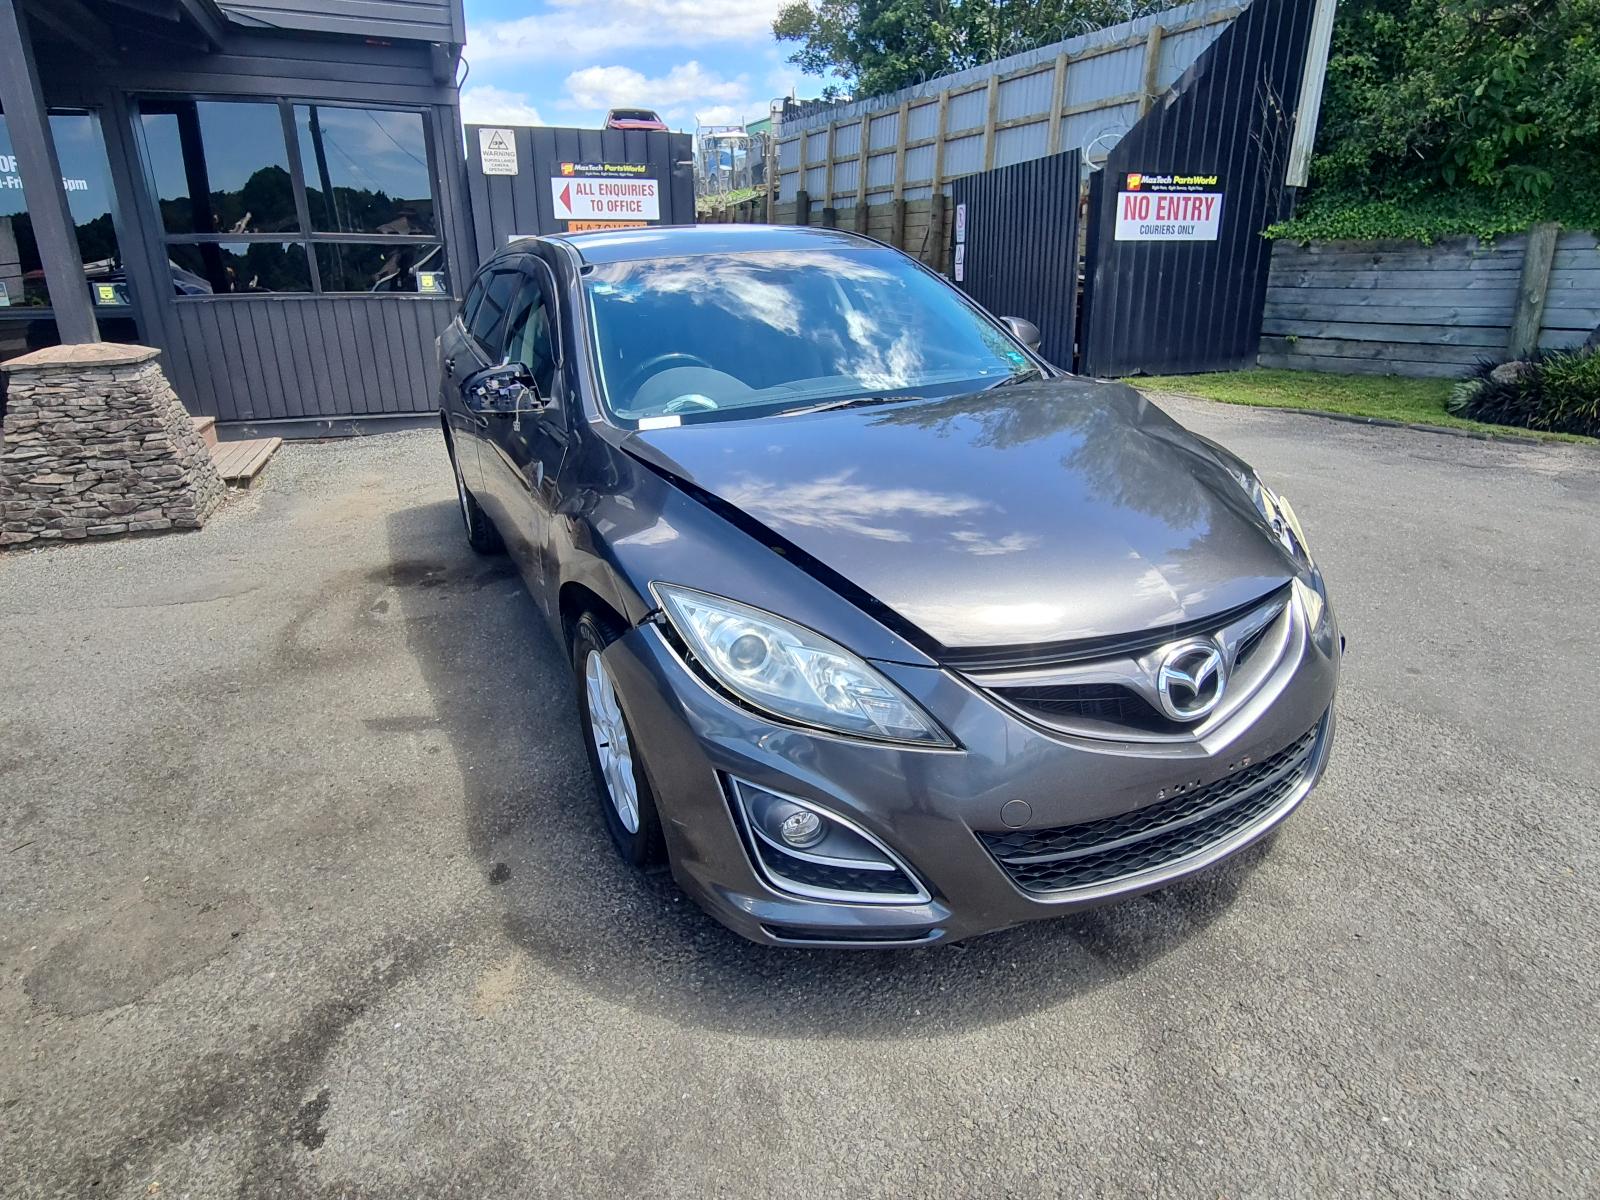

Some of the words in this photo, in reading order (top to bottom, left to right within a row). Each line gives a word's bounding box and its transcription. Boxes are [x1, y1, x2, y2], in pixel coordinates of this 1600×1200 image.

[604, 164, 646, 173] PartsWorld
[1141, 176, 1172, 184] MaxTech
[1173, 176, 1217, 185] PartsWorld
[576, 183, 595, 196] ALL
[599, 183, 655, 197] ENQUIRIES
[590, 199, 603, 212] TO
[607, 200, 643, 212] OFFICE
[1123, 195, 1150, 221] NO
[1156, 196, 1215, 221] ENTRY
[1140, 224, 1175, 235] COURIERS
[1177, 225, 1195, 235] ONLY
